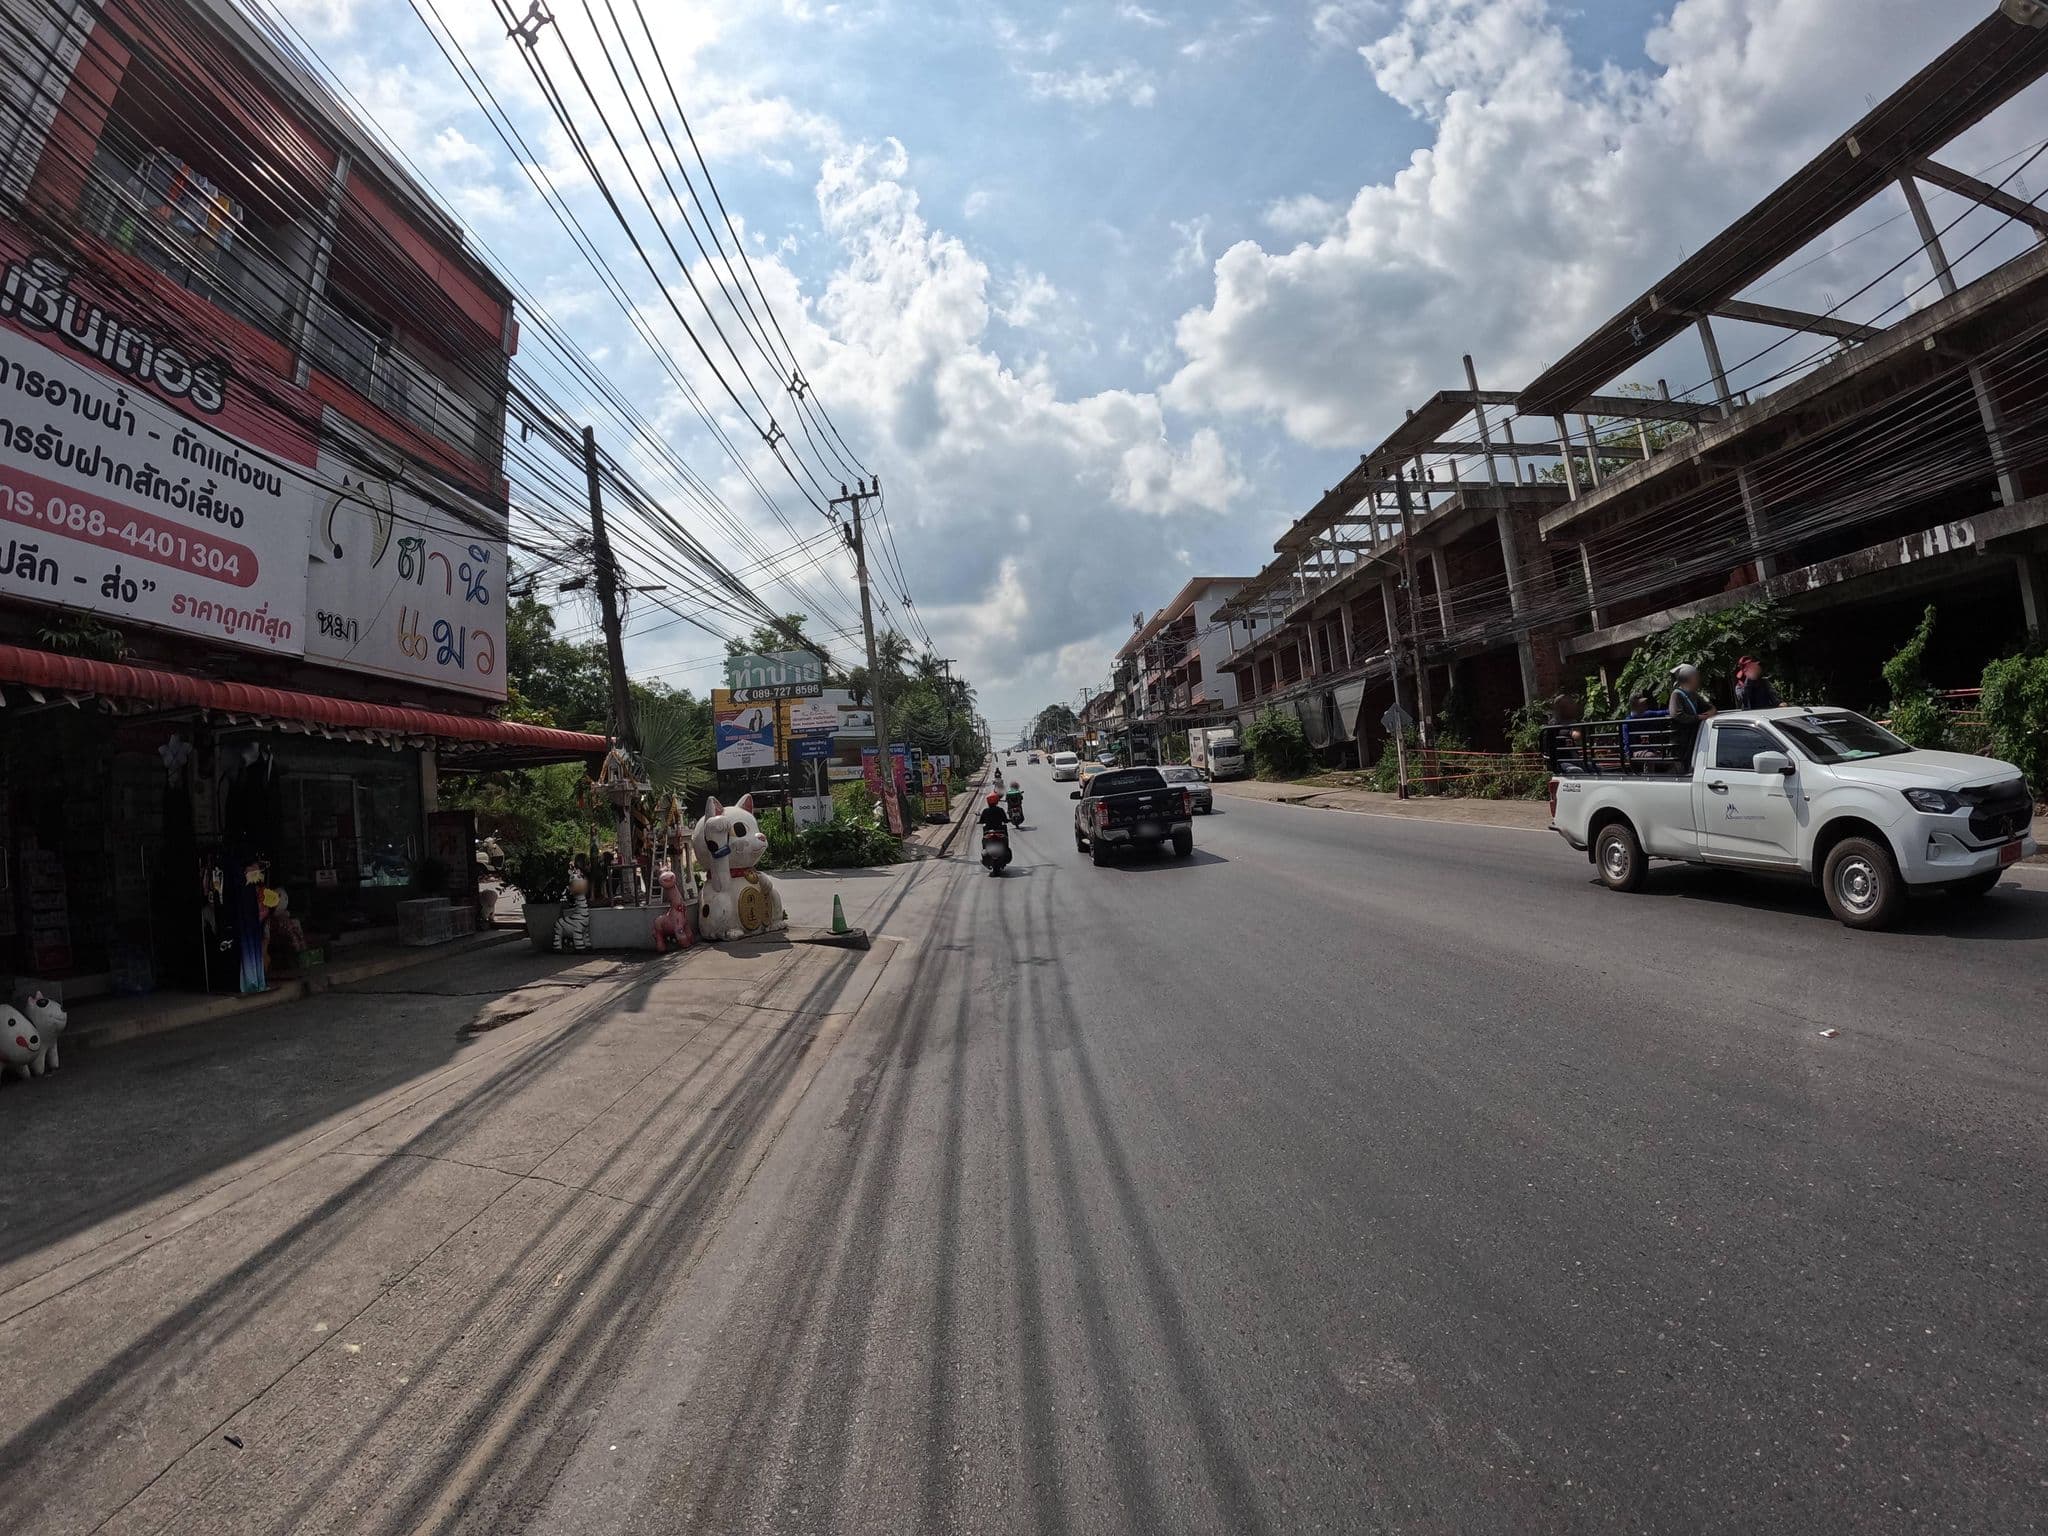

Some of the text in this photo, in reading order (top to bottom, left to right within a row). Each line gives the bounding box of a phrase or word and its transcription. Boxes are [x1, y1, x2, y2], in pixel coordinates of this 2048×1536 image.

[172, 427, 282, 498] ตัดแต่งขน
[171, 593, 292, 644] ราคาถูกที่สุด
[397, 606, 495, 676] แมว
